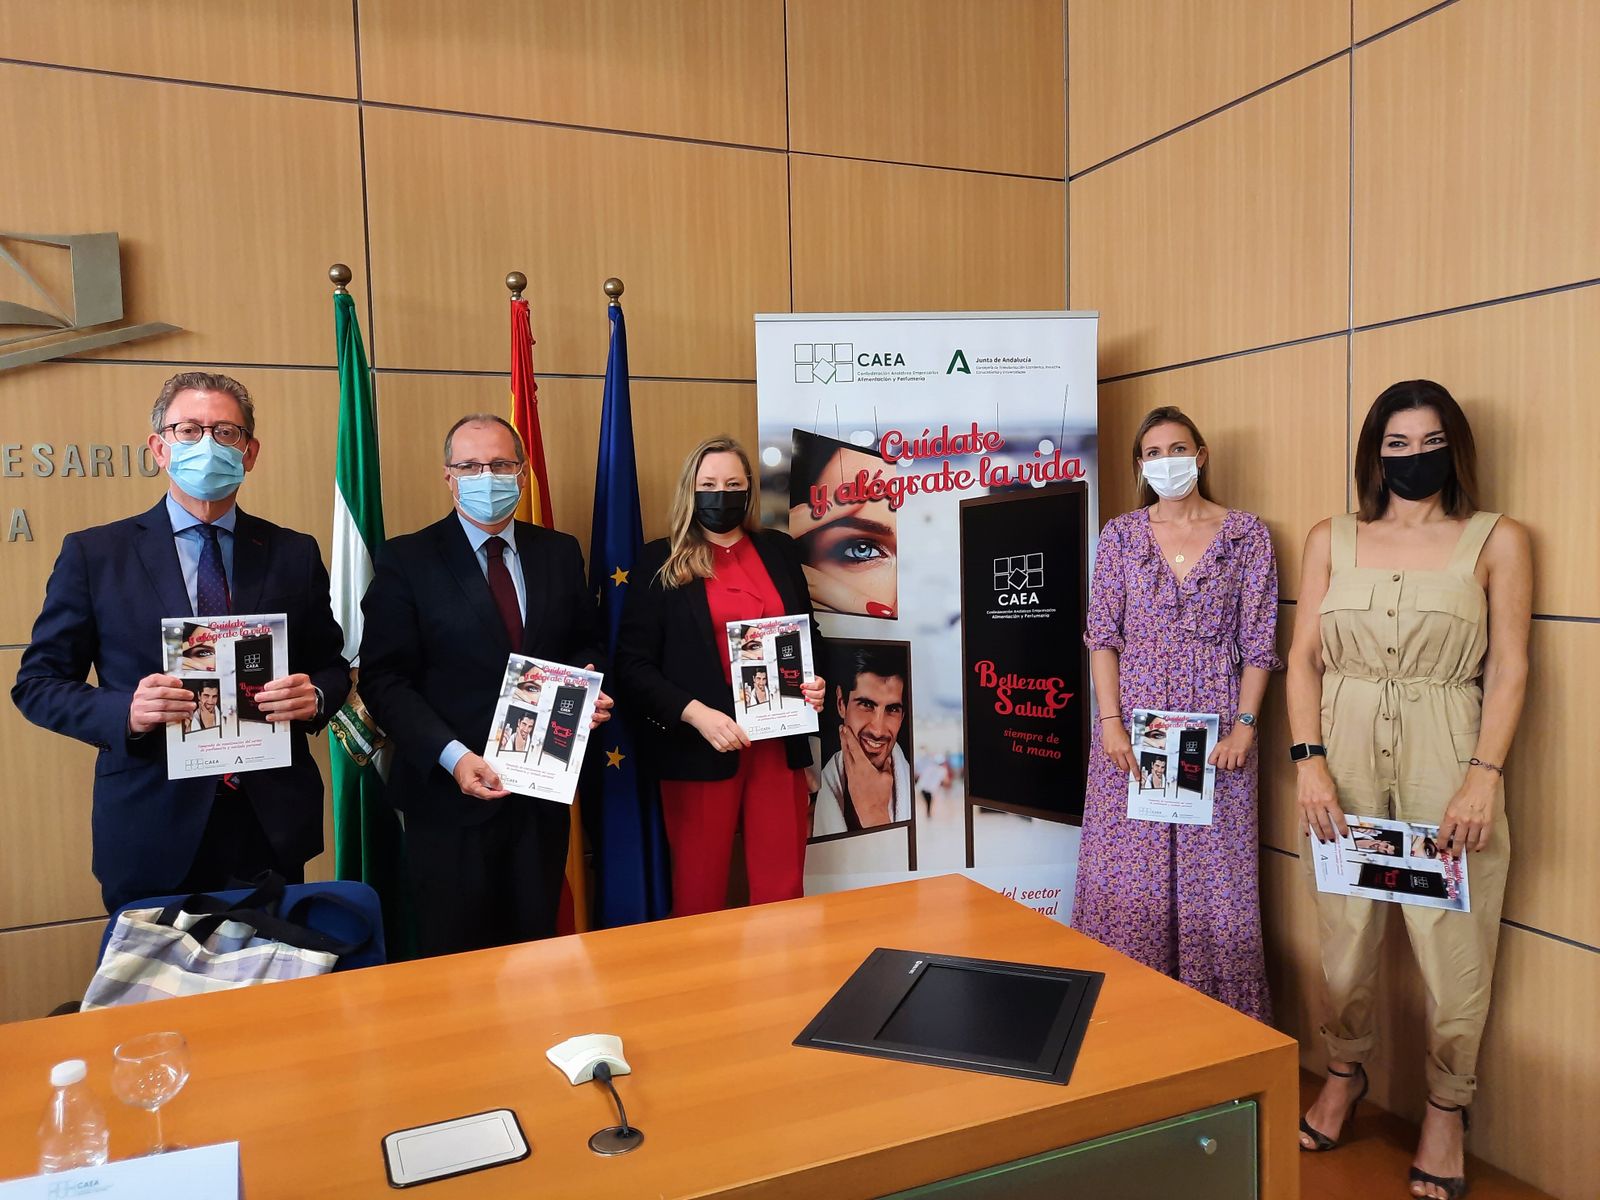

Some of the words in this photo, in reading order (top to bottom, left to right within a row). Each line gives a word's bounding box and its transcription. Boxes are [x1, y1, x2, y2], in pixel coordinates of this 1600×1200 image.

[857, 352, 906, 368] CAEA
[880, 422, 1005, 463] Cuídate
[810, 482, 832, 518] y
[836, 460, 974, 509] alégrate
[978, 455, 1014, 488] la
[1017, 448, 1086, 482] vida
[998, 592, 1040, 606] CAEA
[975, 660, 1048, 690] Belleza
[1045, 677, 1074, 709] &
[995, 687, 1056, 718] Salud
[1003, 728, 1043, 742] siempre
[1046, 733, 1060, 744] de
[1012, 740, 1023, 753] la
[1027, 746, 1062, 760] mano
[1020, 888, 1061, 900] sector
[1032, 901, 1058, 916] nal
